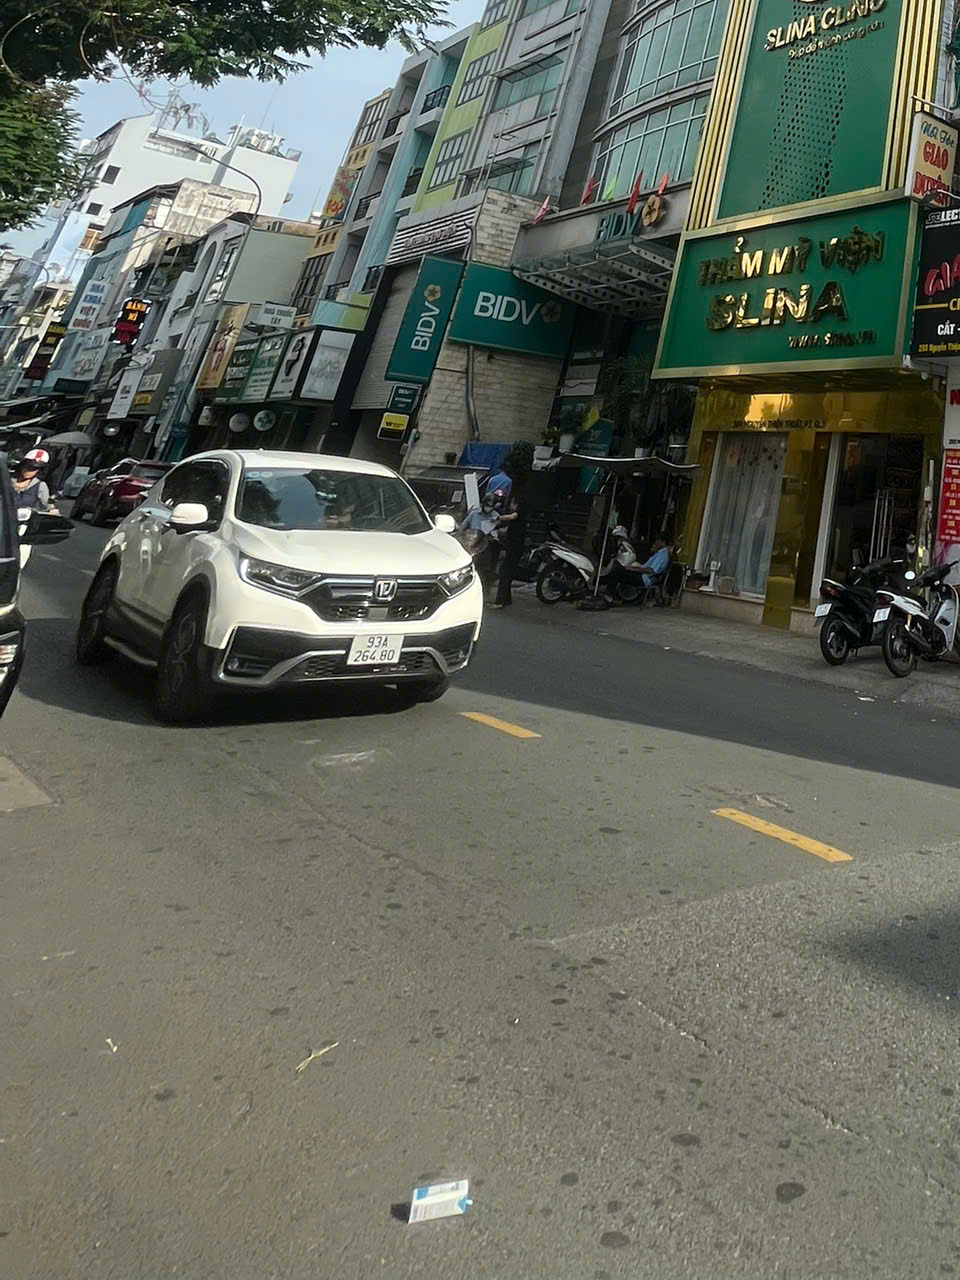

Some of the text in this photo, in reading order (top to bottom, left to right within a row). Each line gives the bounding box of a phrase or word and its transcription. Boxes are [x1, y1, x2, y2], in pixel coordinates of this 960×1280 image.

[764, 15, 817, 51] SLINA
[473, 290, 542, 325] BIDV
[705, 281, 849, 331] SLINA
[411, 300, 441, 352] BIDV
[937, 320, 956, 336] CẮT
[353, 649, 396, 663] 264.80
[367, 636, 389, 648] 93A
